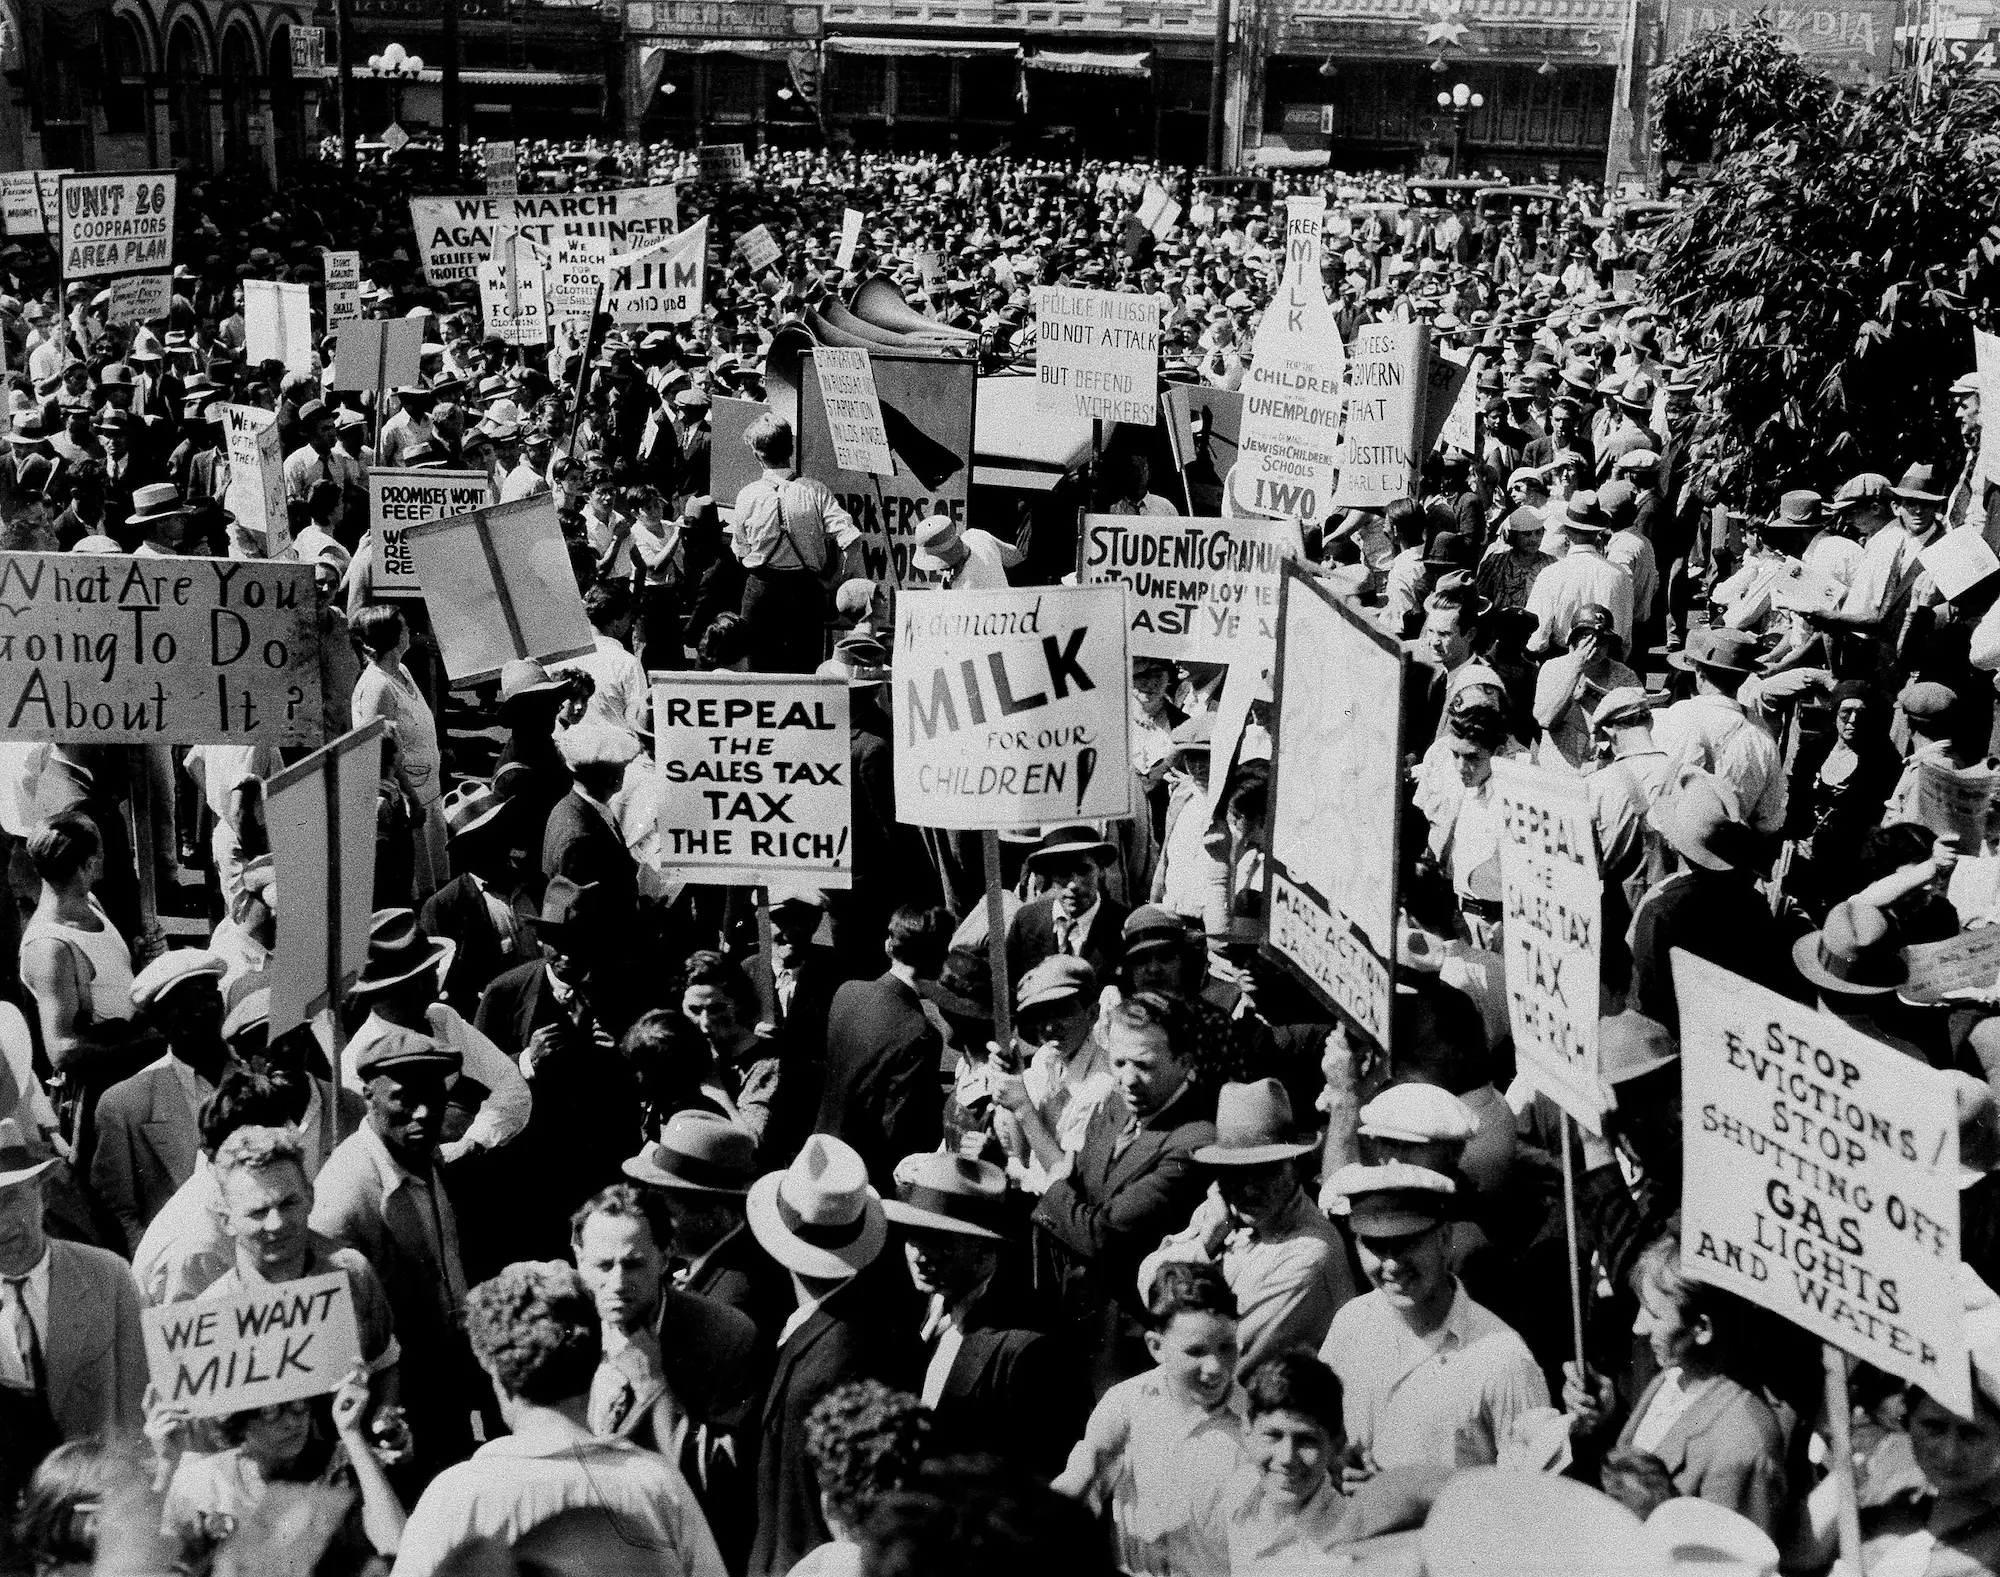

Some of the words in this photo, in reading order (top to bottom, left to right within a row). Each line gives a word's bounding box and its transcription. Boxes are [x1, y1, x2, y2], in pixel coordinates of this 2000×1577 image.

[66, 184, 125, 218] UNIT
[135, 183, 166, 215] 26
[454, 200, 500, 220] WE
[513, 195, 617, 219] MARCH
[73, 217, 166, 239] COOPRATORS
[431, 224, 554, 249] AGAST
[564, 217, 674, 242] HUNGER
[568, 240, 586, 251] WE
[1289, 219, 1319, 237] FREE
[68, 243, 119, 271] AREA
[125, 239, 167, 264] PLAN
[430, 252, 476, 265] RELIEF
[559, 251, 605, 264] MARCH
[563, 273, 598, 285] FOOD
[1042, 294, 1094, 317] POLICE
[1101, 300, 1113, 319] IN
[1119, 302, 1157, 325] USSR
[1042, 321, 1059, 341] DO
[1064, 324, 1094, 344] NOT
[1101, 328, 1158, 351] ATTACK
[1041, 365, 1069, 386] BUT
[1076, 370, 1132, 393] DEFEND
[1254, 368, 1339, 394] CHILDREN
[1249, 397, 1339, 428] UNEMPLOYED
[1352, 400, 1387, 421] THAT
[1242, 437, 1286, 456] JEWISH
[1262, 455, 1315, 477] SCHOOLS
[381, 486, 447, 505] PROMISES
[450, 487, 486, 505] WONT
[1087, 526, 1208, 570] STUDENTS
[1208, 530, 1281, 574] GRADU
[0, 558, 111, 604] What
[118, 561, 193, 606] Are
[211, 560, 300, 609] You
[929, 596, 1042, 637] demand
[1131, 603, 1199, 635] AST
[1208, 605, 1277, 640] YEA
[118, 605, 177, 665] To
[211, 608, 289, 669] Do
[7, 667, 168, 732] About
[907, 626, 1096, 748] MILK
[667, 698, 836, 730] REPEAL
[709, 736, 774, 755] THE
[987, 730, 1032, 751] FOR
[1038, 725, 1097, 749] OUR
[666, 760, 763, 784] SALES
[773, 761, 844, 786] TAX
[919, 747, 1098, 816] CHILDREN!
[703, 791, 795, 823] TAX
[668, 828, 732, 855] THE
[751, 825, 848, 867] RICH!
[1502, 797, 1585, 867] REPEAL
[1508, 884, 1553, 940] SALES
[1558, 904, 1593, 951] TAX
[1325, 925, 1386, 997] ACTION
[1521, 939, 1569, 1009] TAX
[1513, 991, 1542, 1043] THE
[1766, 1022, 1860, 1089] STOP
[1725, 1029, 1948, 1170] EVICTIONS!
[1773, 1100, 1866, 1168] STOP
[1702, 1103, 1874, 1213] SHUTTING
[1886, 1194, 1950, 1256] OFF
[1766, 1179, 1864, 1256] GAS
[1753, 1211, 1901, 1315] LIGHTS
[1696, 1230, 1768, 1282] AND
[1793, 1269, 1939, 1369] WATER
[161, 1312, 217, 1353] WE
[236, 1287, 342, 1340] WANT
[173, 1333, 315, 1402] MILK
